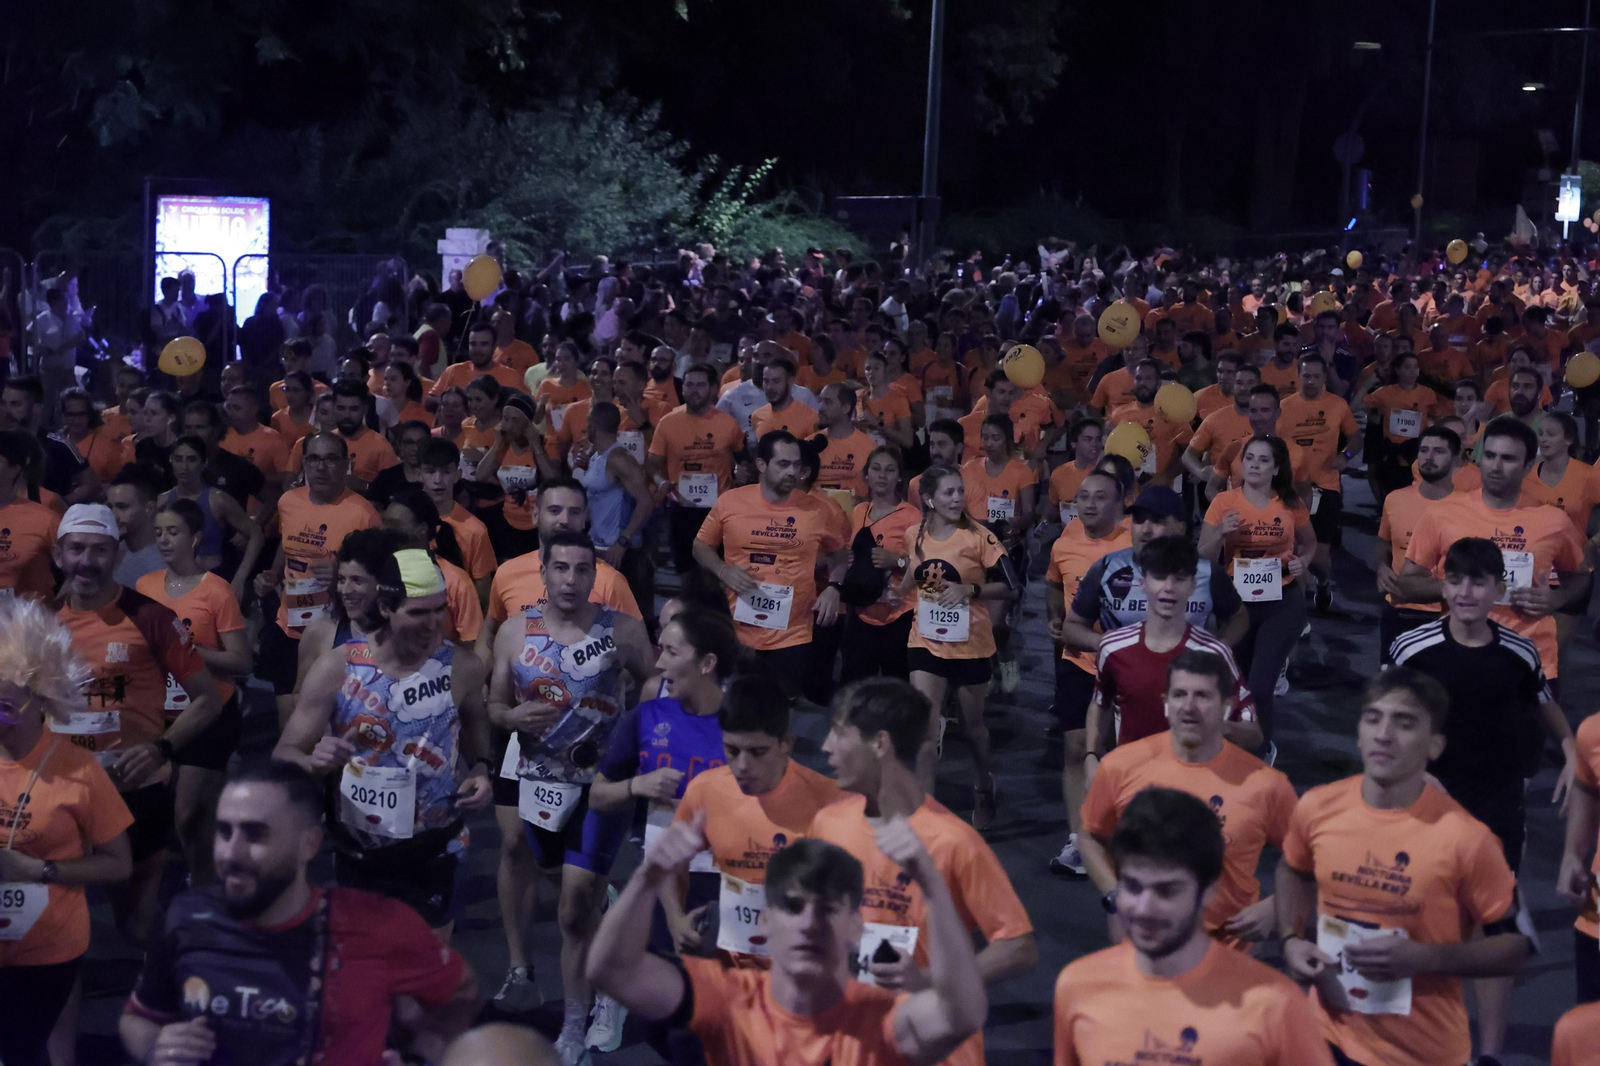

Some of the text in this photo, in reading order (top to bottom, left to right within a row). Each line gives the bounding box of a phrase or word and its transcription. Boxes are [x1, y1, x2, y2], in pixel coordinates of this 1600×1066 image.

[181, 206, 245, 215] CIRQUE DU SOLEIL
[689, 485, 708, 494] 8152
[287, 534, 310, 545] SEVILLA
[299, 531, 327, 541] NOCTURNA
[751, 530, 779, 538] SEVILLA
[1507, 543, 1525, 551] KH7
[1243, 573, 1273, 584] 20240
[297, 594, 315, 607] 643
[750, 595, 781, 611] 11261
[929, 609, 960, 623] 11259
[573, 635, 615, 666] BANG
[403, 675, 451, 706] BANG
[351, 784, 397, 809] 20210
[534, 786, 563, 807] 4253
[725, 859, 764, 869] SEVILLA
[1357, 866, 1412, 883] NOCTURNA
[1331, 871, 1409, 896] SEVILLA KH7
[0, 889, 25, 908] 59
